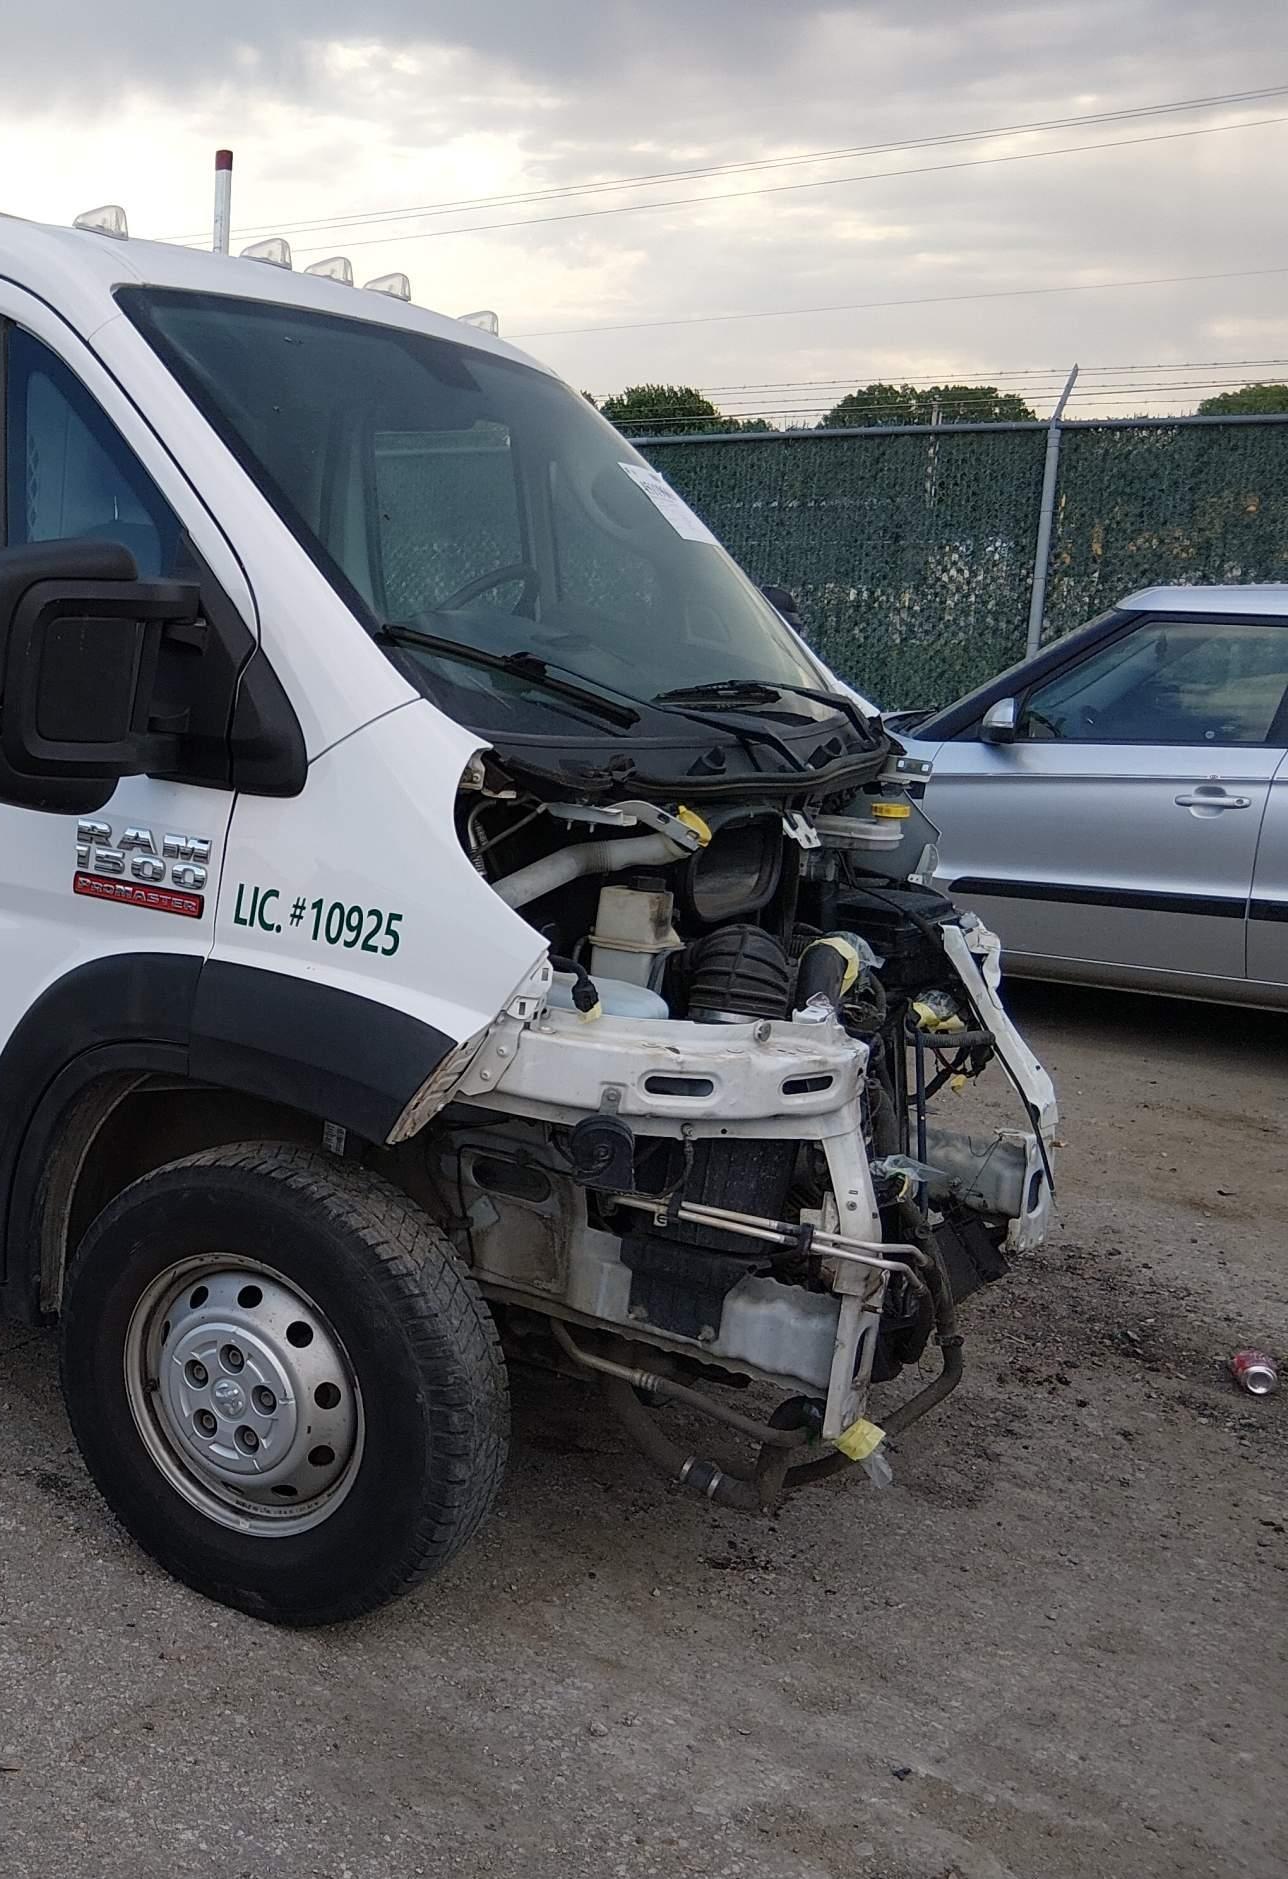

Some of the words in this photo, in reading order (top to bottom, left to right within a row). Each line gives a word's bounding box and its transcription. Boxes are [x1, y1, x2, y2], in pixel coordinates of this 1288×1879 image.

[77, 817, 212, 865] RAM
[75, 843, 208, 891] 1500
[233, 883, 282, 934] LIC.
[289, 896, 404, 957] #10925
